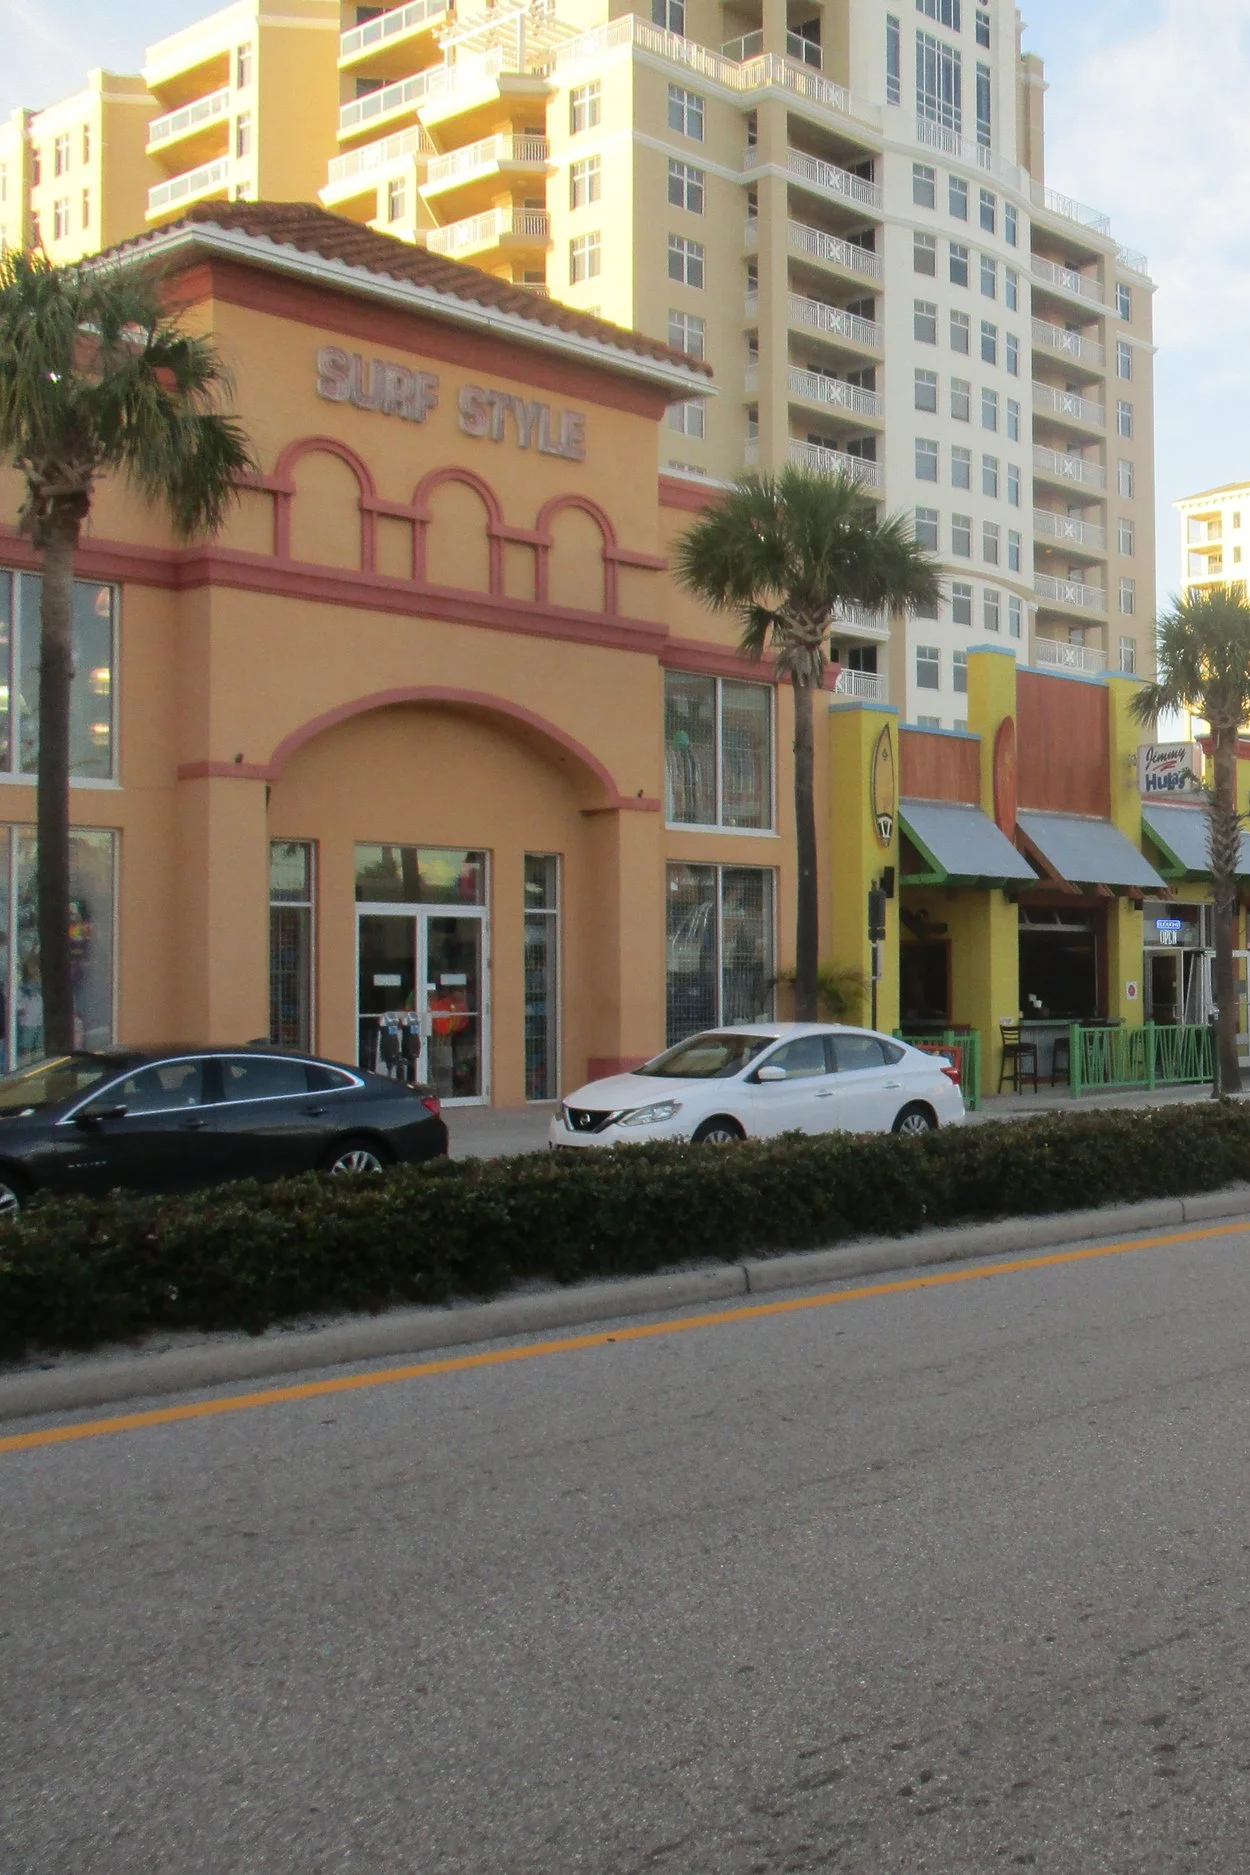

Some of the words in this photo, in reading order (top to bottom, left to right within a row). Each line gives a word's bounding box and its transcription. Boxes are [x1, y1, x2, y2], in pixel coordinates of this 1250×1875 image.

[317, 346, 439, 424] SURF
[458, 384, 587, 462] STYLE
[1145, 746, 1186, 770] Jimmy
[1159, 930, 1177, 945] OPEN
